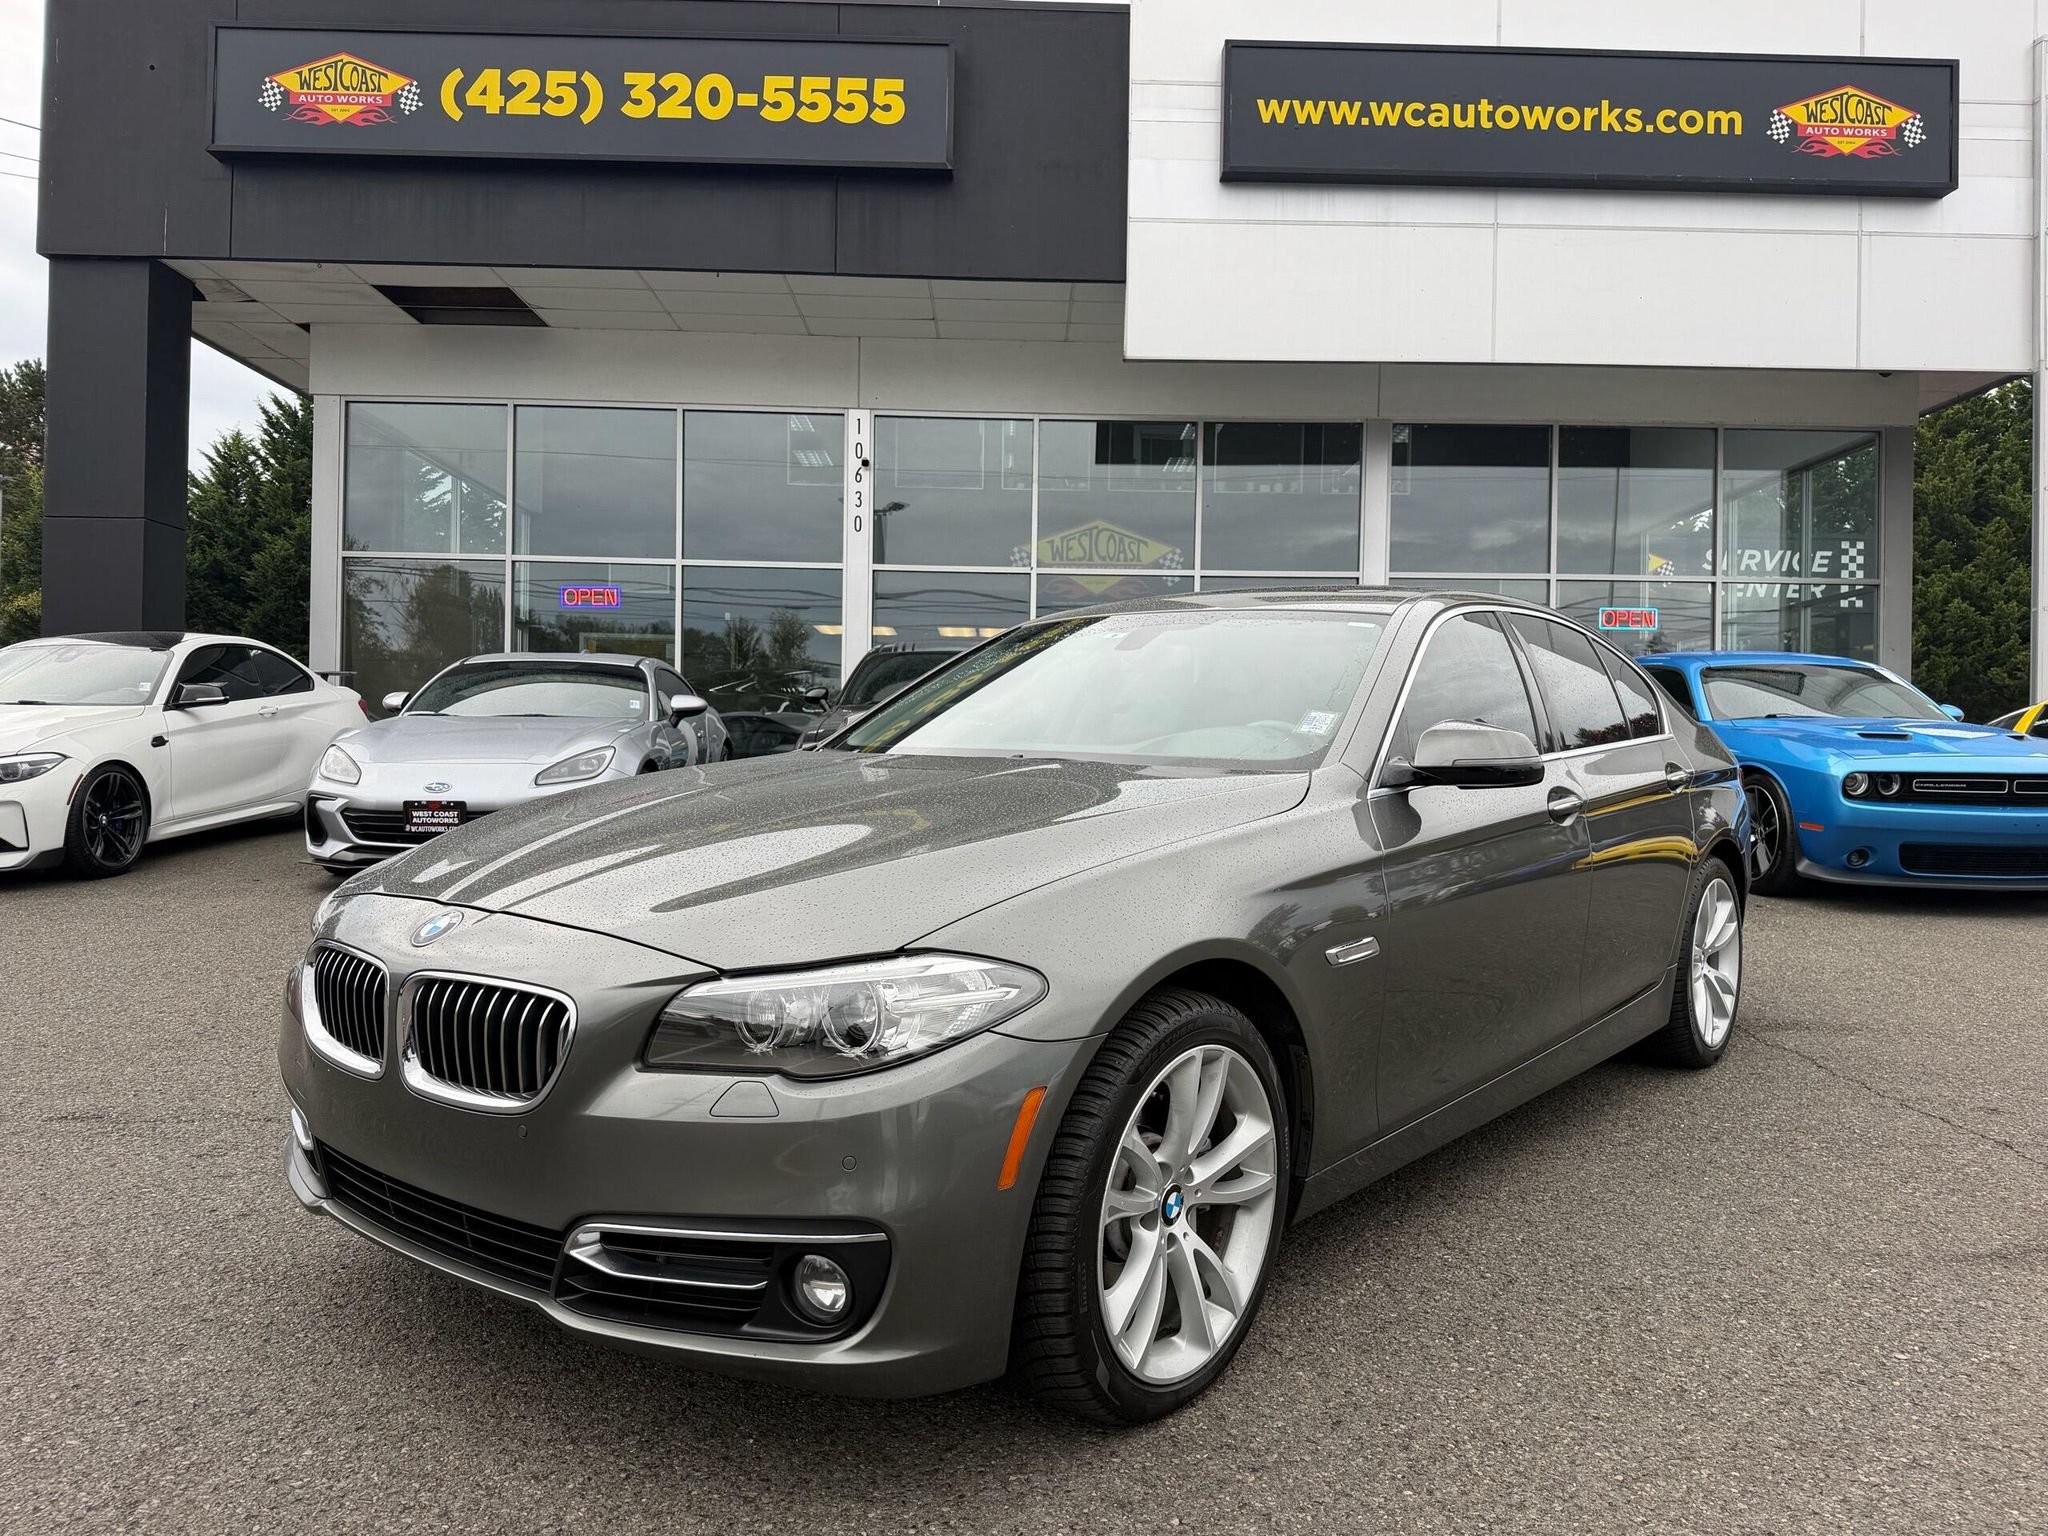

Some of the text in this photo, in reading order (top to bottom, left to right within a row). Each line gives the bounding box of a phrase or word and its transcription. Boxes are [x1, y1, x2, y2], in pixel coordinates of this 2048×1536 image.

[299, 94, 383, 104] AUTO WORKS
[441, 68, 905, 124] (425) 320-5555
[1258, 99, 1742, 134] www.wcautoworks.com
[1806, 127, 1888, 137] AUTO WORKS
[854, 418, 863, 532] 10630
[564, 588, 617, 606] OPEN
[1602, 610, 1655, 628] OPEN
